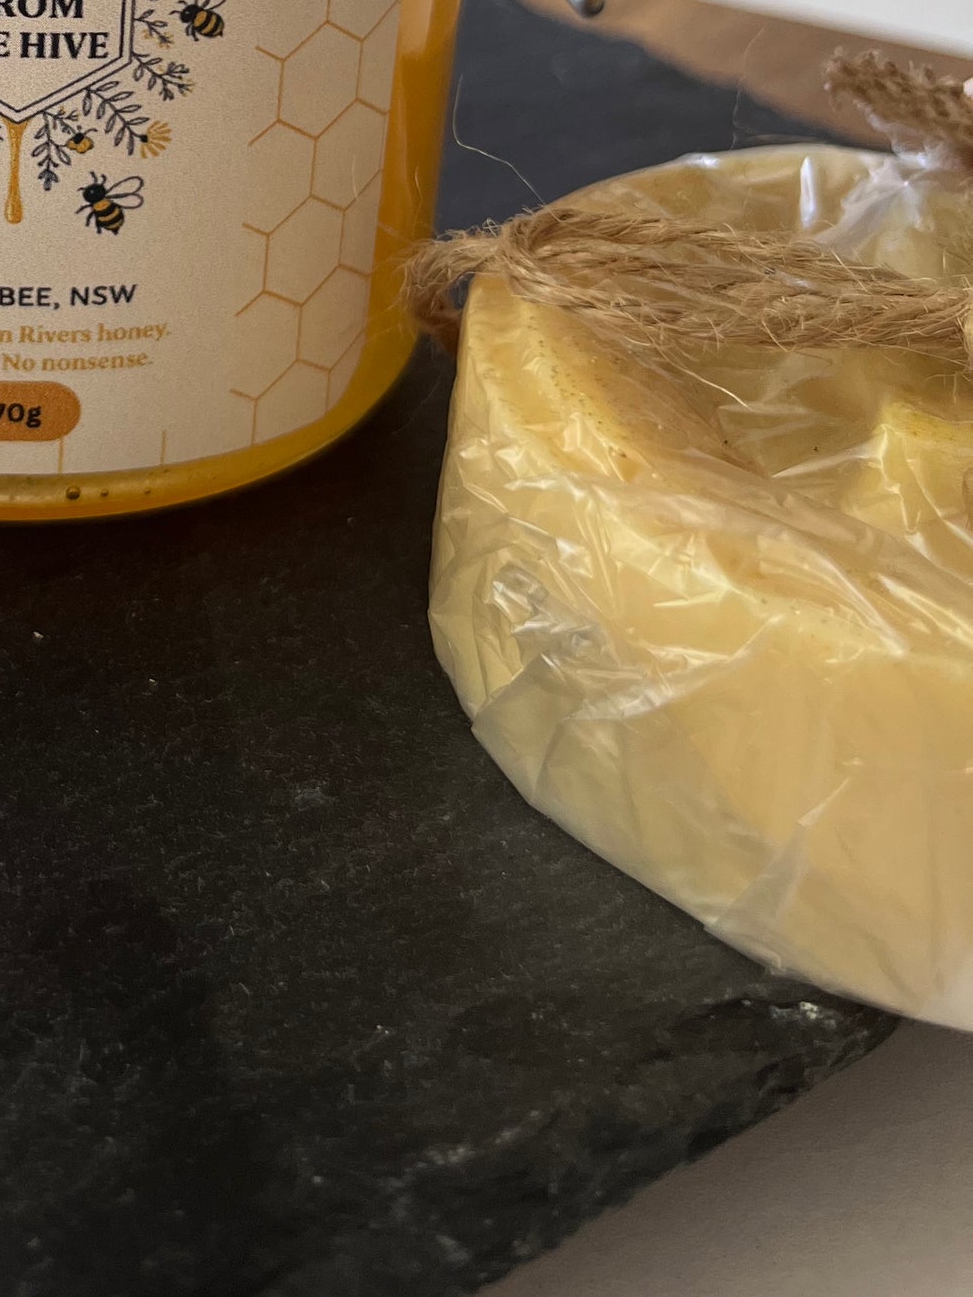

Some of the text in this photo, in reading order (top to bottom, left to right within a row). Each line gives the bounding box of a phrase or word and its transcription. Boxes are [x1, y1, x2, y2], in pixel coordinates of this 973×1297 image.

[20, 30, 109, 60] HIVE
[70, 283, 137, 306] NSW
[18, 324, 92, 344] Rivers
[97, 322, 171, 342] honey.
[1, 352, 36, 372] No
[41, 351, 153, 372] nonsense.
